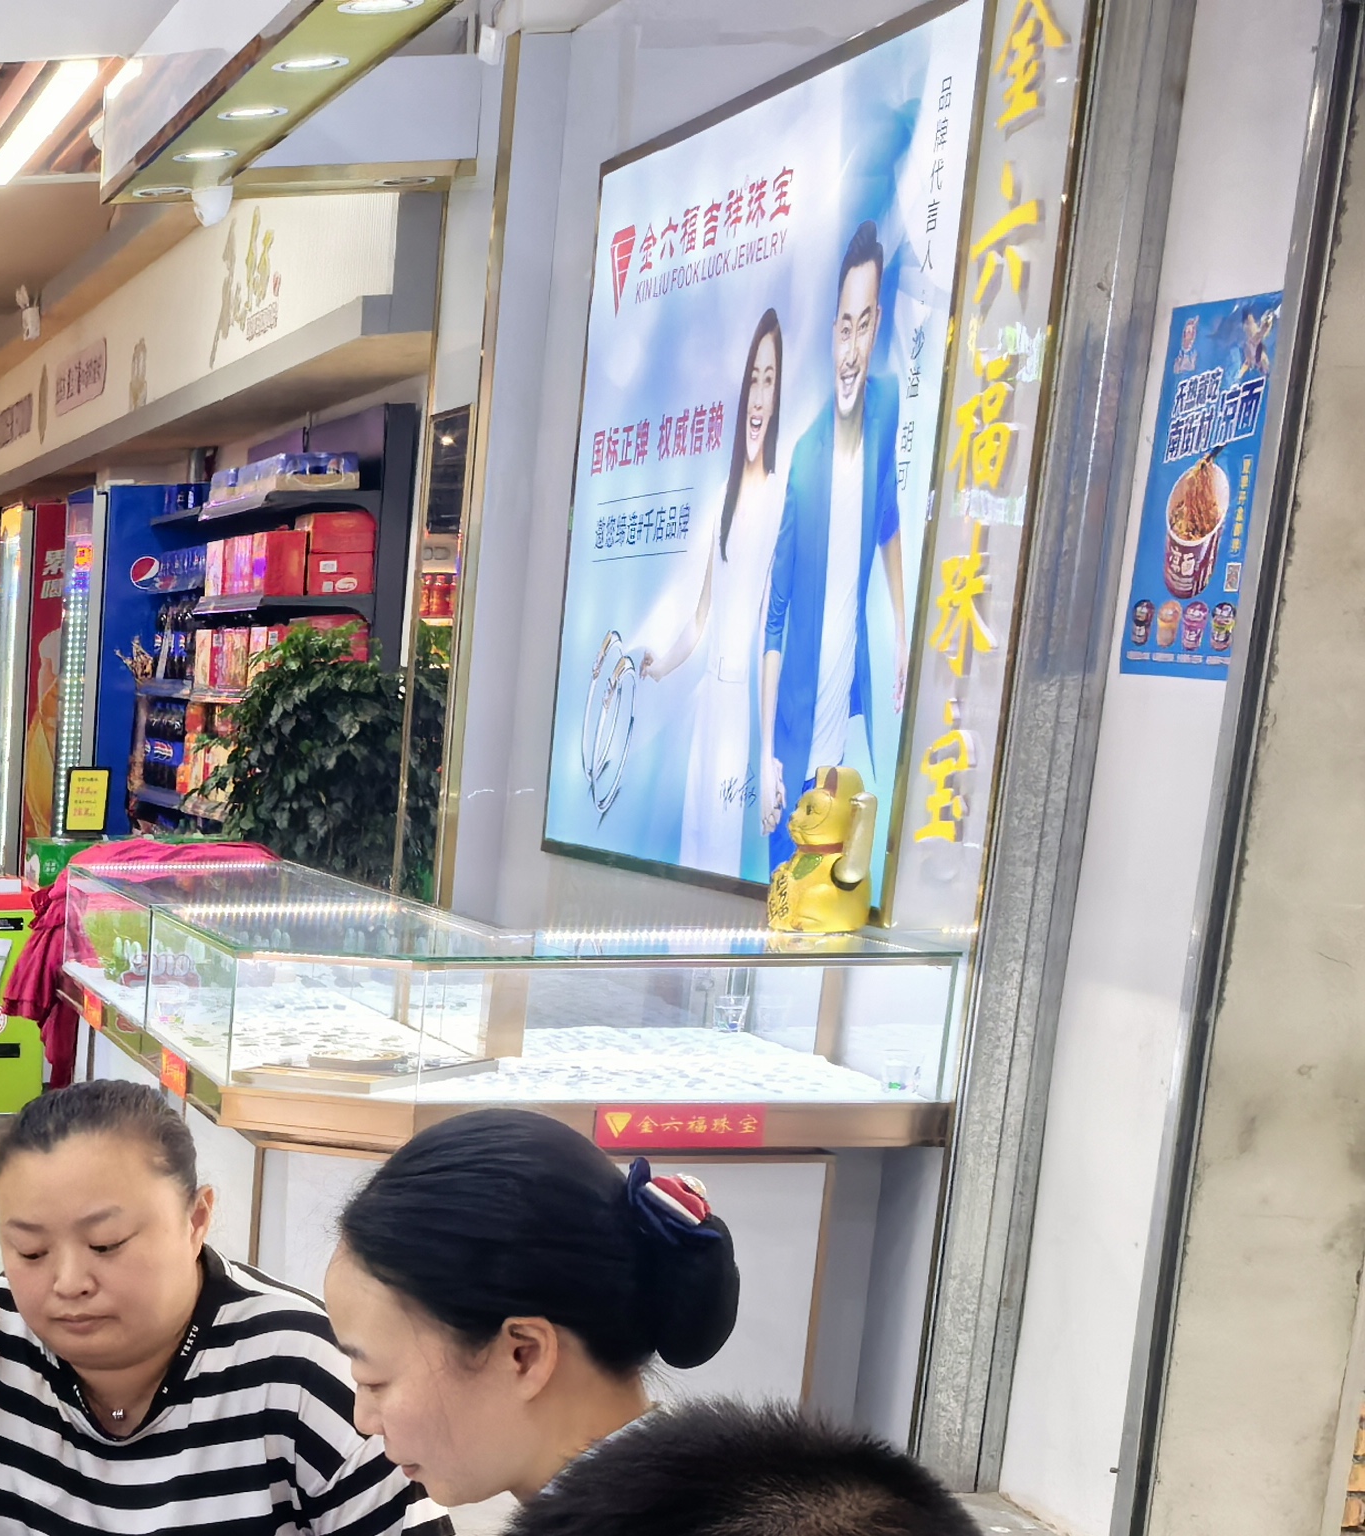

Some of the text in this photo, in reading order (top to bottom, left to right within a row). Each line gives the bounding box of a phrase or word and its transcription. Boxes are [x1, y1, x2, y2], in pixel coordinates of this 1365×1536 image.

[639, 165, 795, 275] 金六福吉祥珠宝
[635, 228, 788, 304] KIN LIU FOOK LUCK JEWELRY
[590, 400, 724, 477] 国标正牌 权威信赖
[914, 0, 1067, 845] 金六福珠宝
[637, 1114, 759, 1134] 金六福珠宝
